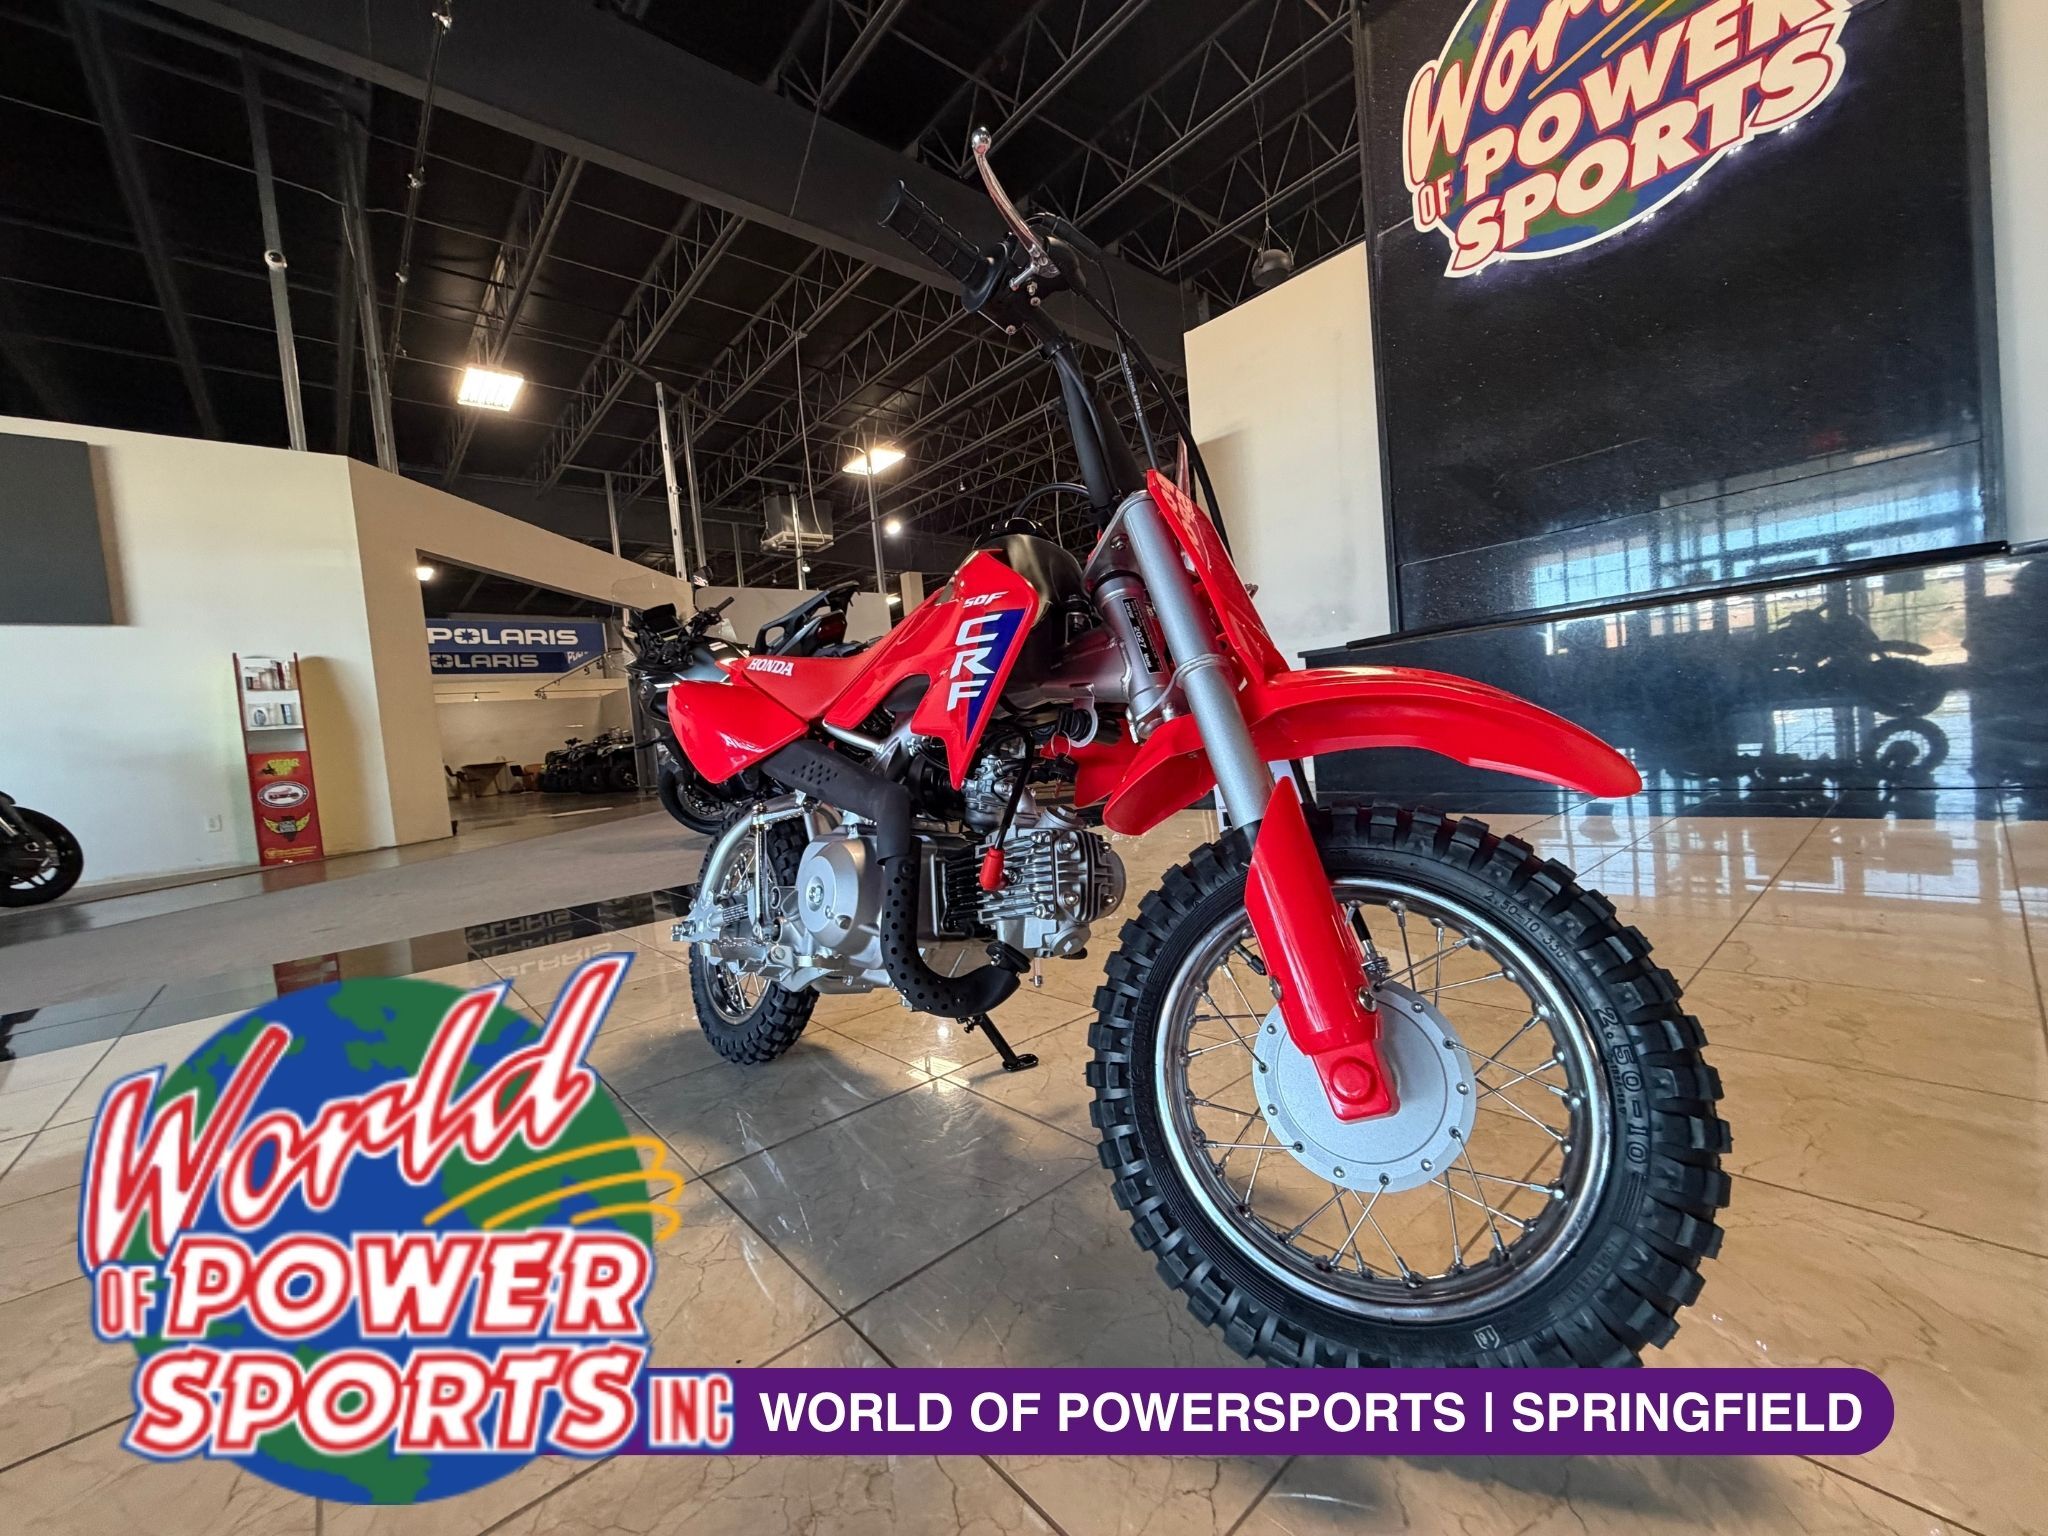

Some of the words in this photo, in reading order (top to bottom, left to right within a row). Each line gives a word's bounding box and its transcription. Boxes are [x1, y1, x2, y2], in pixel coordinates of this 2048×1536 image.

[1408, 0, 1625, 185] Wor
[1452, 22, 1834, 271] SPORTS
[1418, 170, 1453, 226] OF
[963, 591, 1009, 608] 50F
[427, 627, 579, 646] POLARIS
[431, 653, 540, 669] OLARIS
[747, 658, 794, 676] HONDA
[947, 613, 1003, 712] CRF
[1484, 890, 1541, 932] 2.50-10
[1594, 1007, 1649, 1164] 2.50-10
